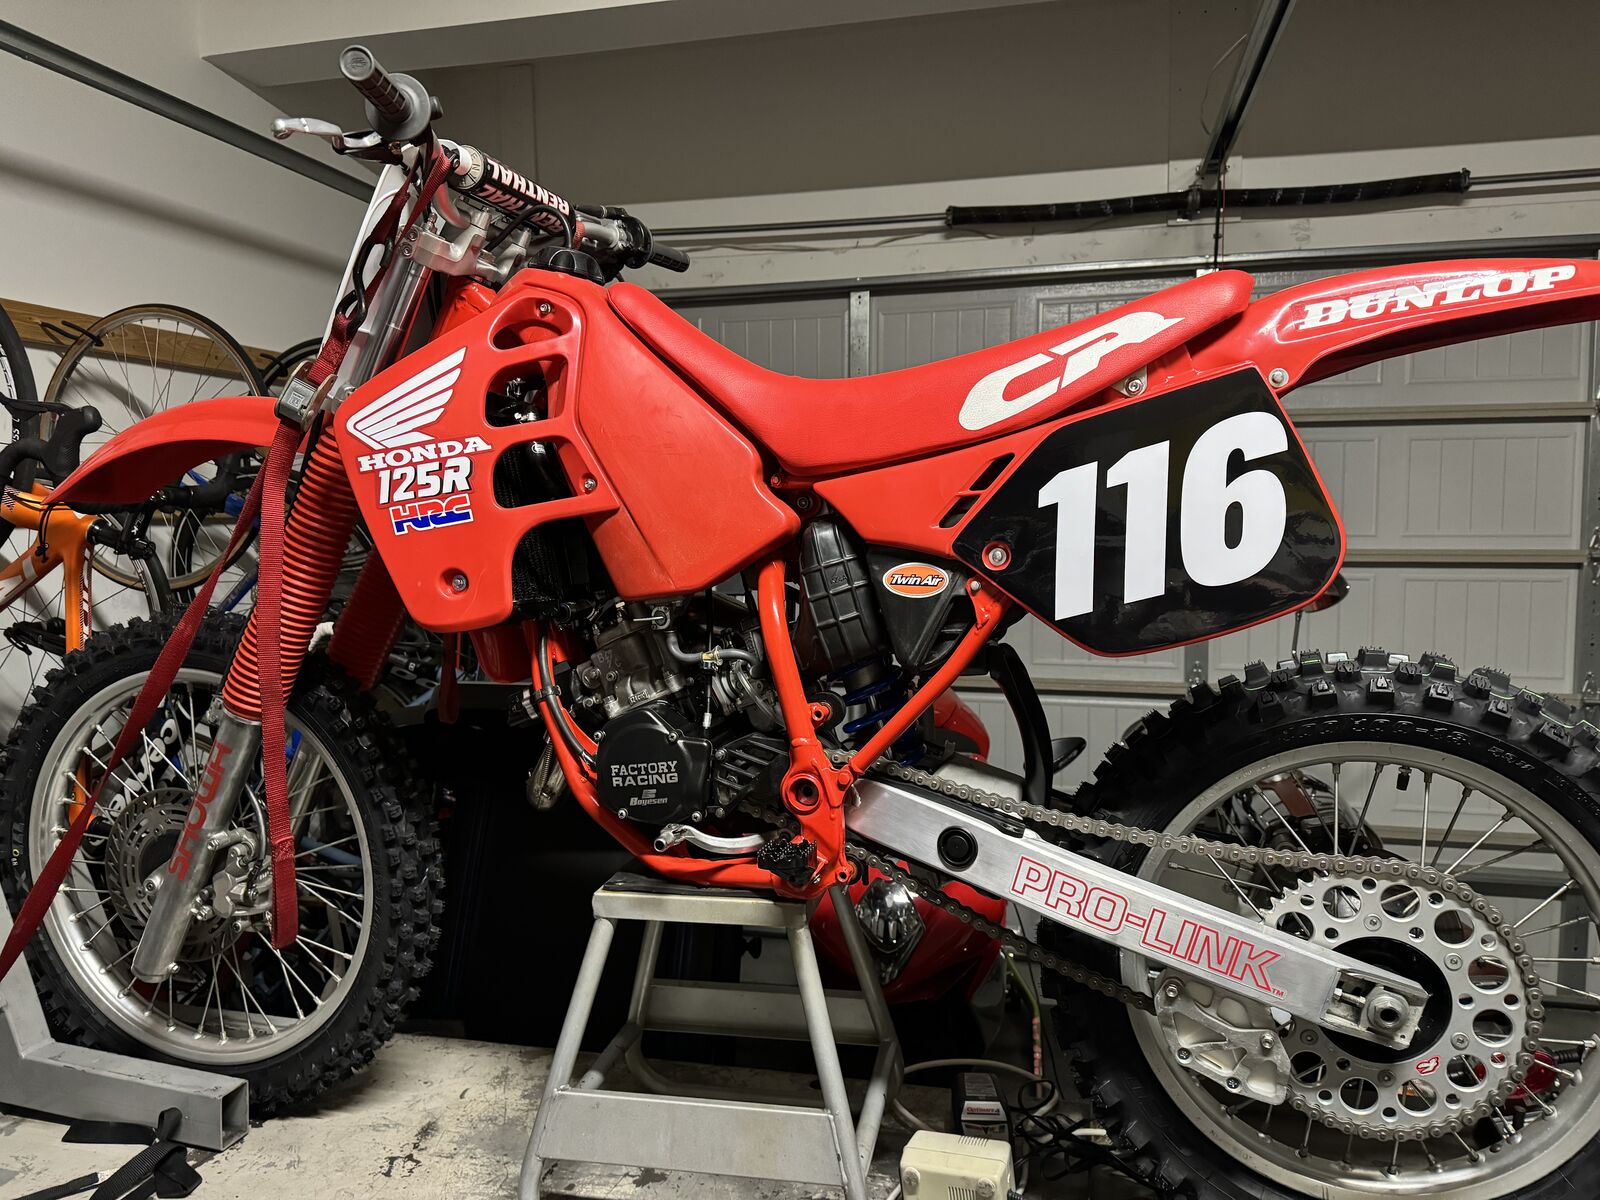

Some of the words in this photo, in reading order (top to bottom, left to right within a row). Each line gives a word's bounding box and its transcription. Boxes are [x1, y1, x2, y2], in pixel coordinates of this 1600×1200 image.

[486, 157, 570, 216] RENTHAL
[1298, 264, 1576, 330] DUNLOP
[958, 311, 1186, 431] CR
[357, 436, 492, 472] HONDA
[378, 456, 473, 505] 125R
[389, 493, 475, 536] HRC
[1038, 411, 1288, 621] 116
[891, 573, 921, 586] Twin
[921, 575, 944, 587] Air
[610, 760, 678, 776] FACTORY
[612, 772, 679, 787] RACING
[168, 738, 233, 881] SHOWA
[629, 796, 668, 807] Boyesen
[1011, 856, 1281, 992] PRO-LINK
